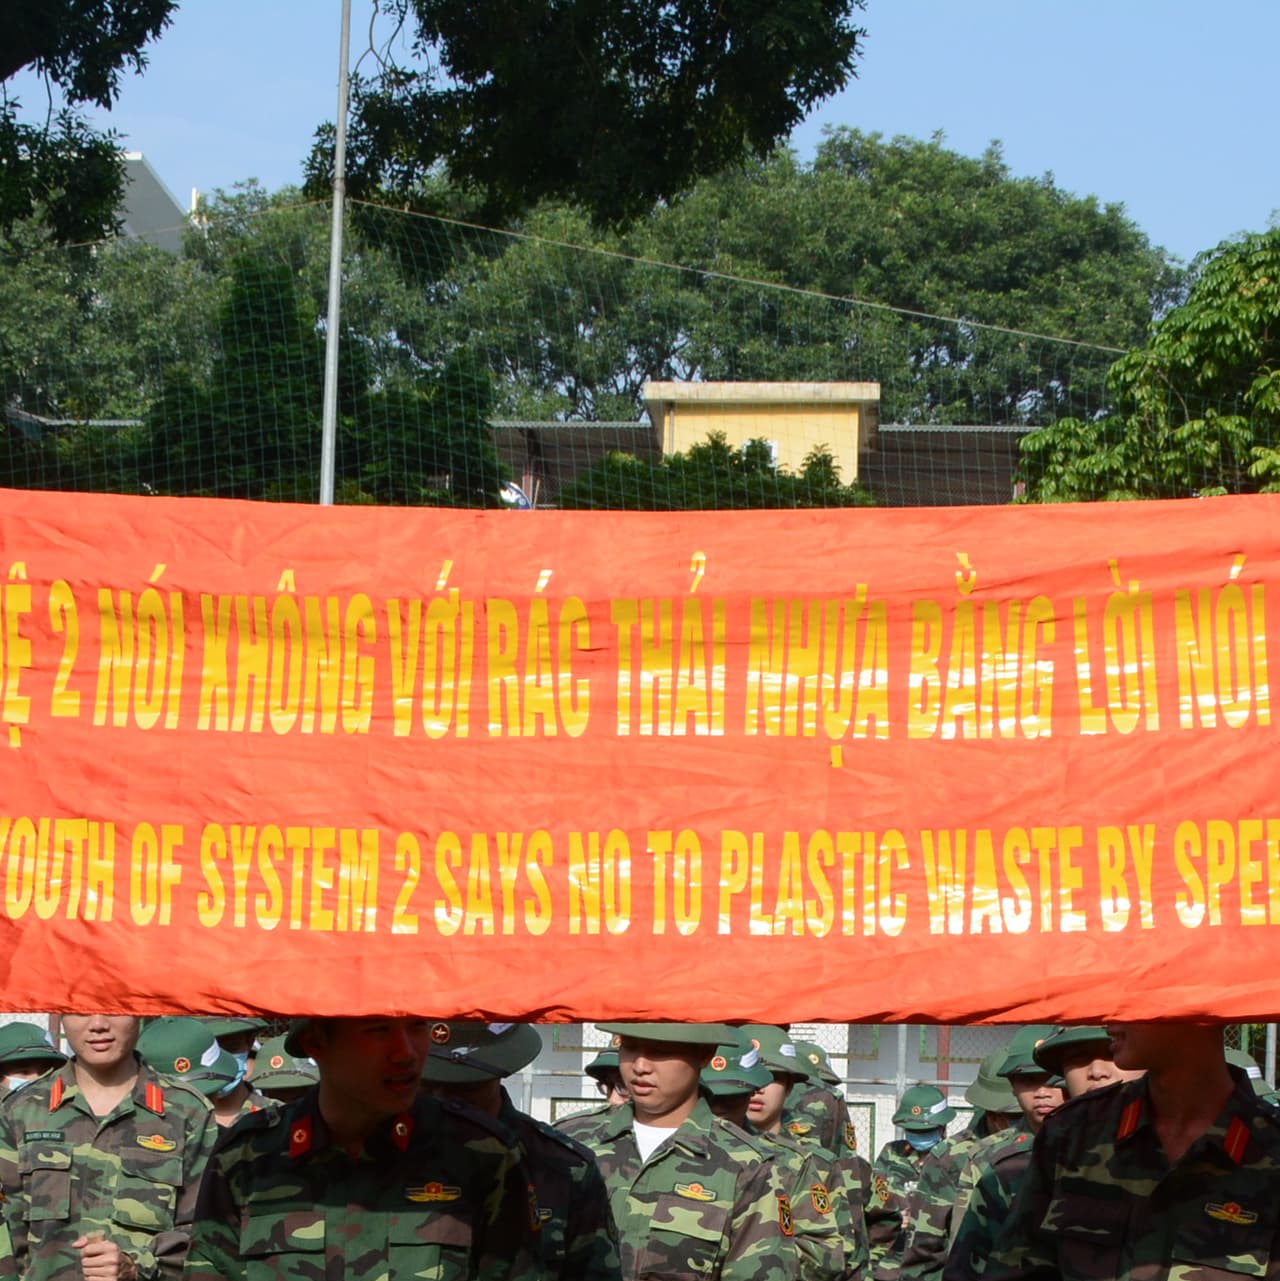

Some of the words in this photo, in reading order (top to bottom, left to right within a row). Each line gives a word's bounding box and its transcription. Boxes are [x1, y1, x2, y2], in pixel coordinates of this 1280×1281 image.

[49, 580, 80, 717] 2
[93, 564, 184, 729] NÓI
[197, 569, 376, 735] KHÔNG
[387, 560, 473, 739] VỚI
[487, 569, 590, 738] RÁC
[611, 551, 726, 737] THẢI
[745, 583, 890, 768] NHỰA
[908, 552, 1055, 740] BẰNG
[1072, 559, 1160, 735] LỜI
[1175, 554, 1271, 729] NÓI
[130, 822, 184, 926] OF
[197, 823, 379, 934] SYSTEM
[391, 832, 422, 935] 2
[434, 830, 554, 936] SAYS
[568, 829, 632, 935] NO
[646, 829, 702, 936] TO
[717, 829, 910, 937] PLASTIC
[920, 825, 1087, 936] WASTE
[1097, 823, 1156, 933] BY
